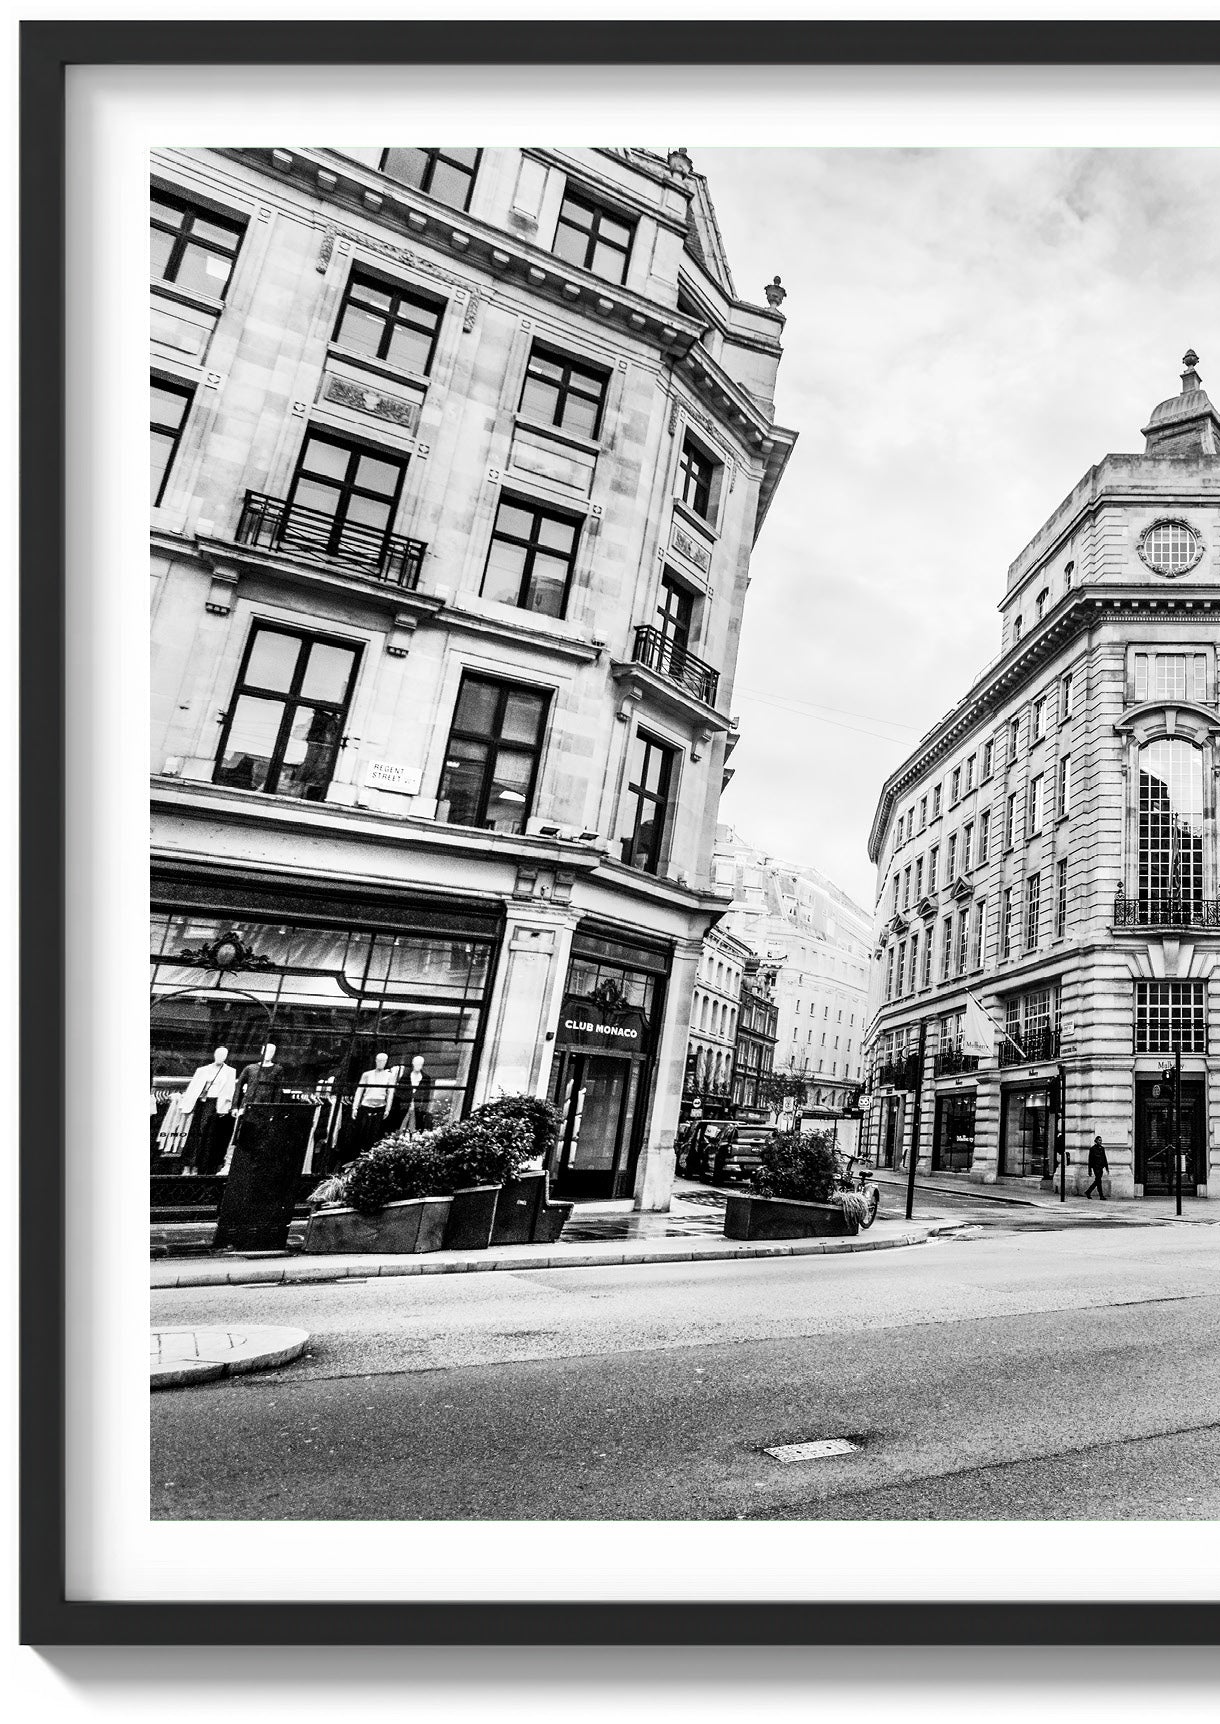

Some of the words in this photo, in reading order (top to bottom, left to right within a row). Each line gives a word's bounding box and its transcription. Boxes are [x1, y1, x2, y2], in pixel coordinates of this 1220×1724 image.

[373, 763, 404, 773] REGENT
[372, 771, 401, 782] STREET
[564, 1019, 594, 1032] CLUB
[595, 1023, 638, 1039] MONACO
